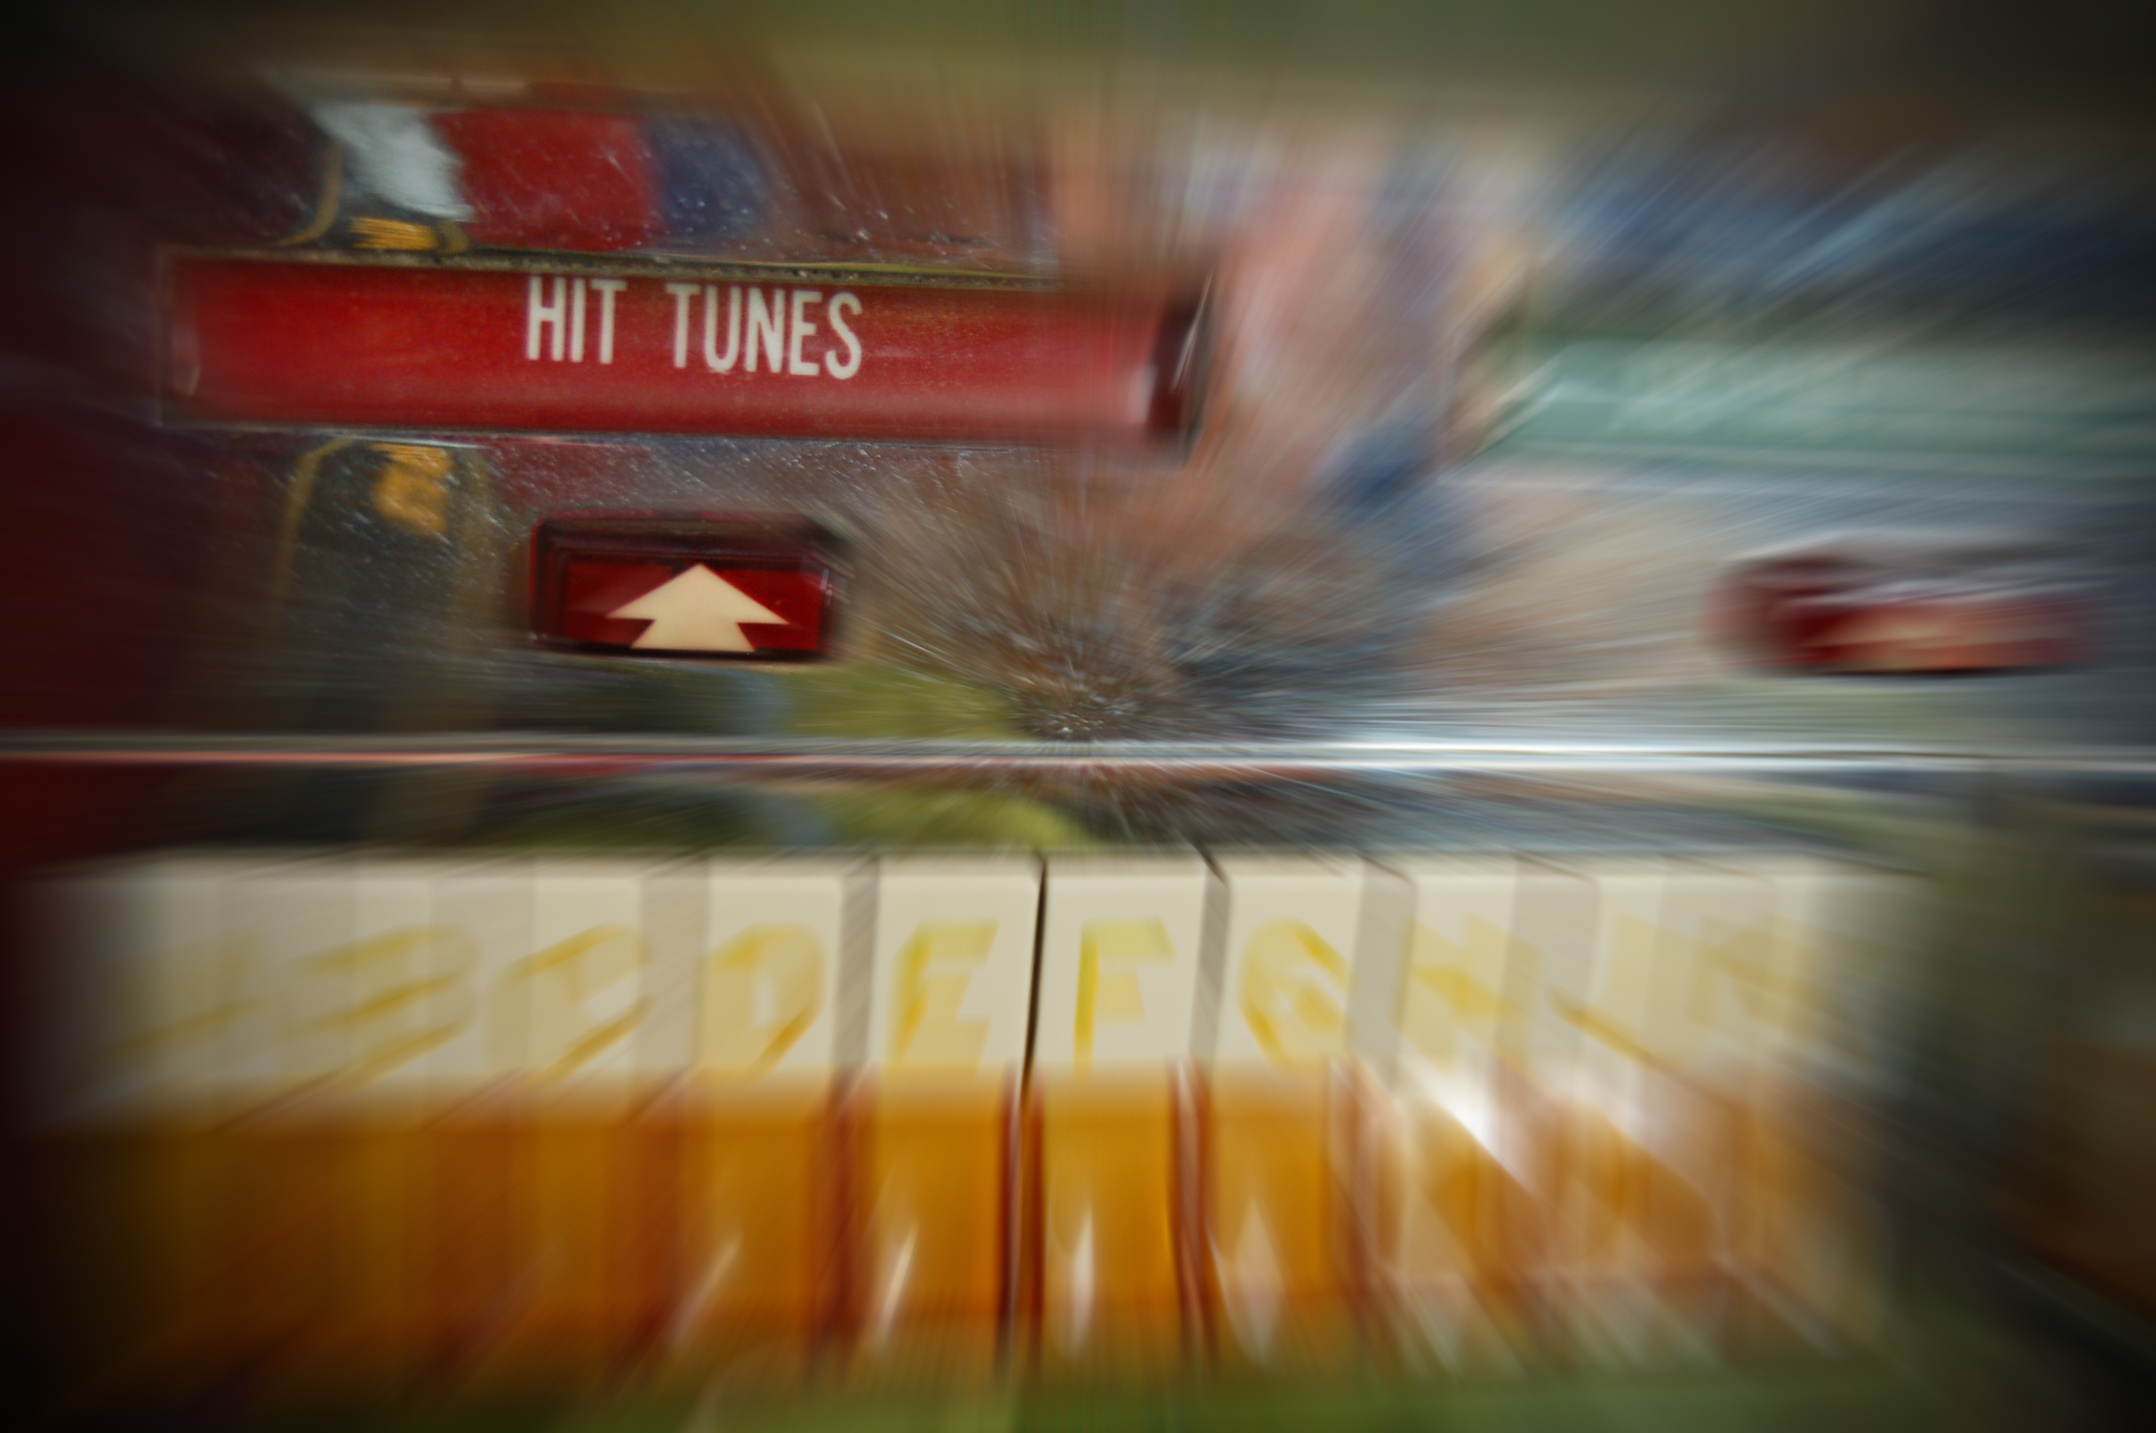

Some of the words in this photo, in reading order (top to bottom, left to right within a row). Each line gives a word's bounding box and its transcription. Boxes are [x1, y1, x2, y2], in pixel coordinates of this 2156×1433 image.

[526, 276, 628, 365] HIT
[665, 281, 863, 380] TUNES
[698, 922, 830, 1083] D
[888, 919, 1000, 1080] E
[1072, 916, 1176, 1082] F
[1237, 916, 1354, 1079] G
